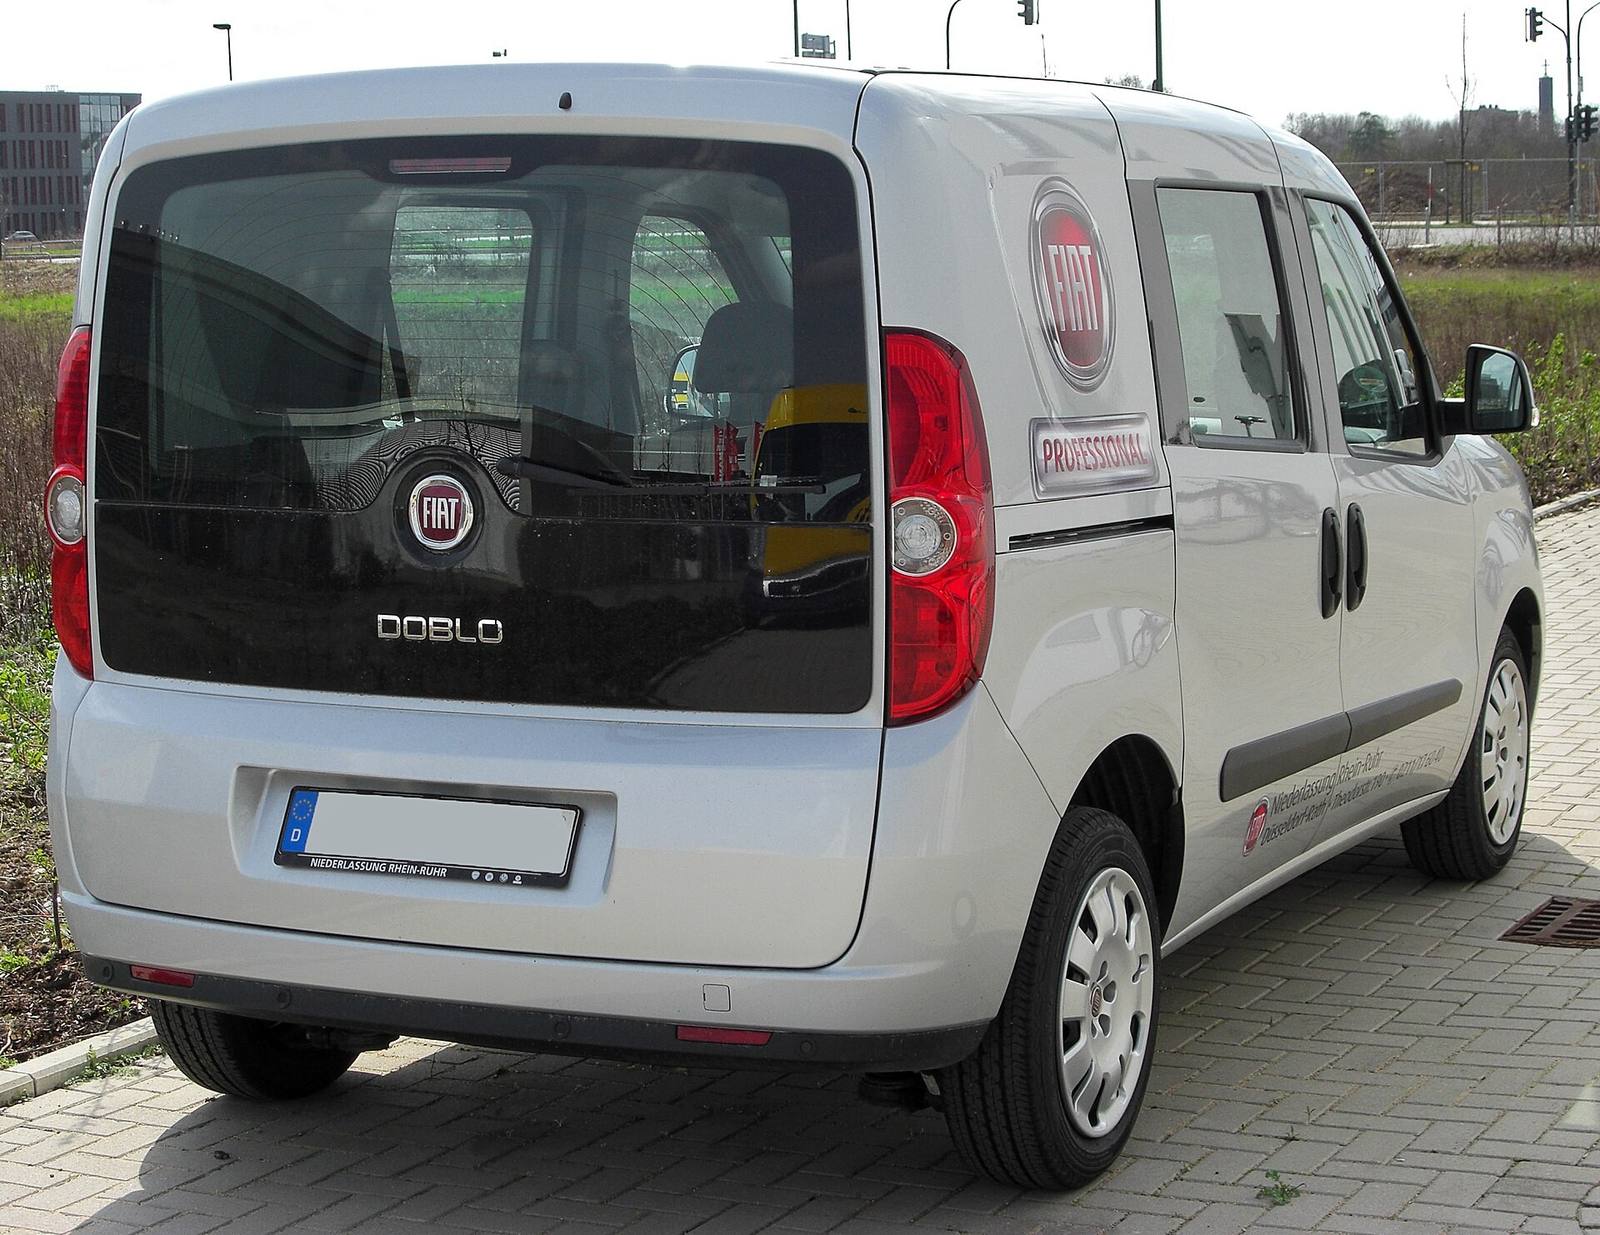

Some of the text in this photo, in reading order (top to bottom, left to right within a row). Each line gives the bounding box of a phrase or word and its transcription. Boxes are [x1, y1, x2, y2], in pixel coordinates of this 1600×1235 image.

[1047, 244, 1099, 332] FIAT
[1042, 432, 1149, 475] PROFESSIONAL
[422, 496, 460, 530] FIAT
[1271, 773, 1337, 816] Niederlassung
[1337, 746, 1384, 785] Rhein-Ruhr
[290, 828, 302, 842] D
[310, 857, 448, 878] NIEDERLASSUNG RHEIN-RUHR
